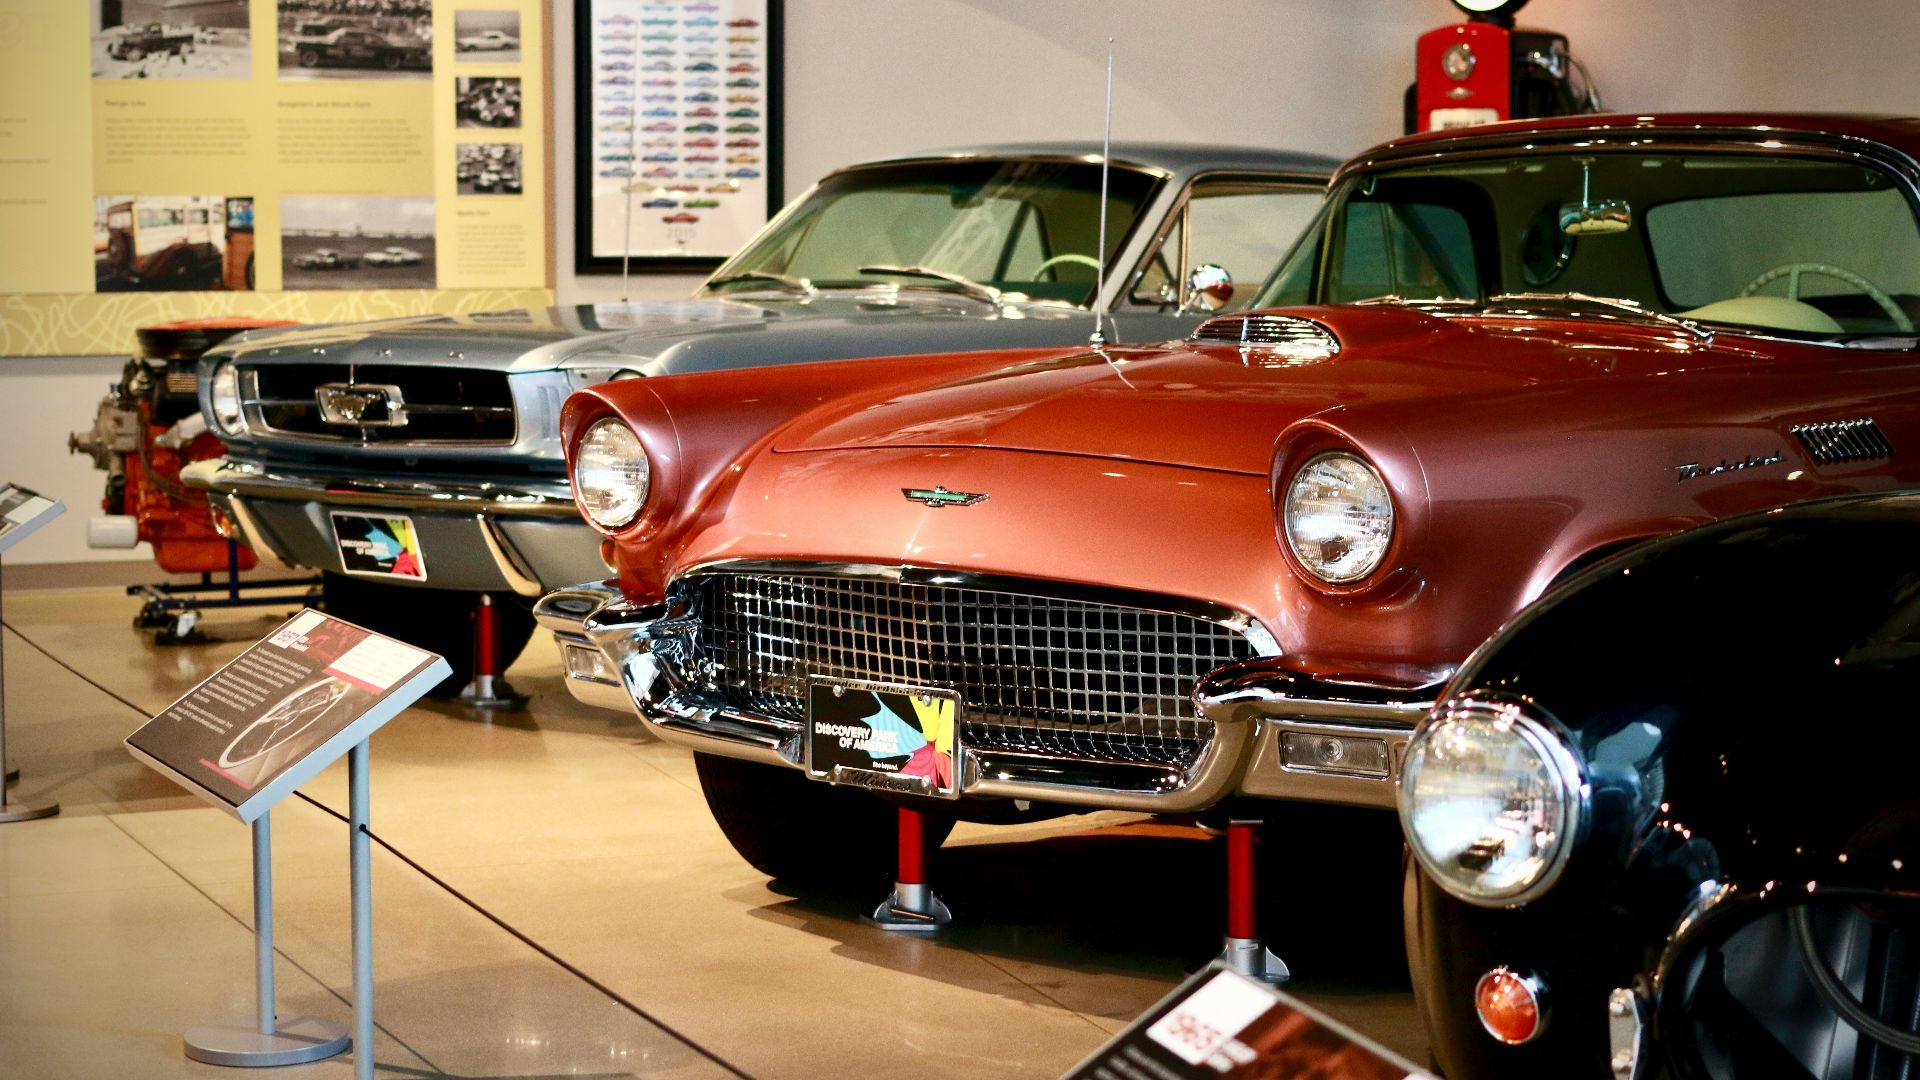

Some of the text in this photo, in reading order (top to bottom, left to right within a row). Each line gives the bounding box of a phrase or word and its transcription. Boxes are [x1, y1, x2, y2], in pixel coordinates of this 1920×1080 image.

[815, 722, 870, 739] DISCOVERY
[839, 737, 899, 753] OF AMERICA
